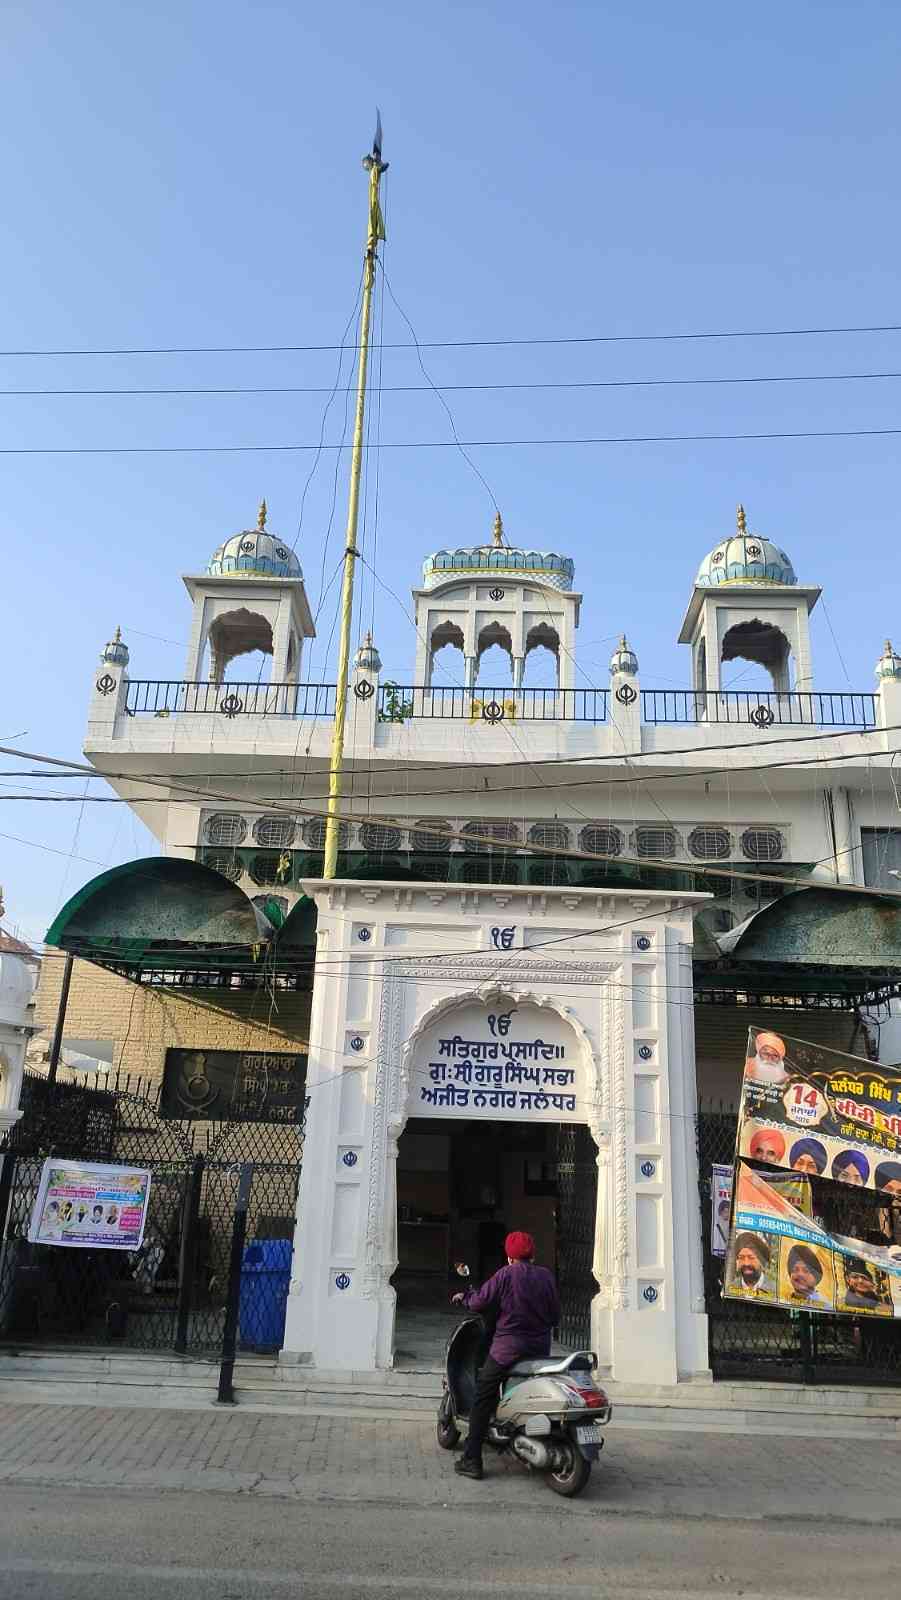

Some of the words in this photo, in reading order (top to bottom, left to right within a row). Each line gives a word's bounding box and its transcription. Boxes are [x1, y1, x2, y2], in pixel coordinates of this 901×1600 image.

[475, 1064, 504, 1089] ਗੁਰੂ
[543, 1068, 575, 1086] ਸਭਾ
[421, 1084, 469, 1107] ਅਜੀਤ
[472, 1089, 517, 1108] ਨਗਰ
[519, 1089, 576, 1111] ਜਲੰਧਰ
[793, 1085, 817, 1108] 14
